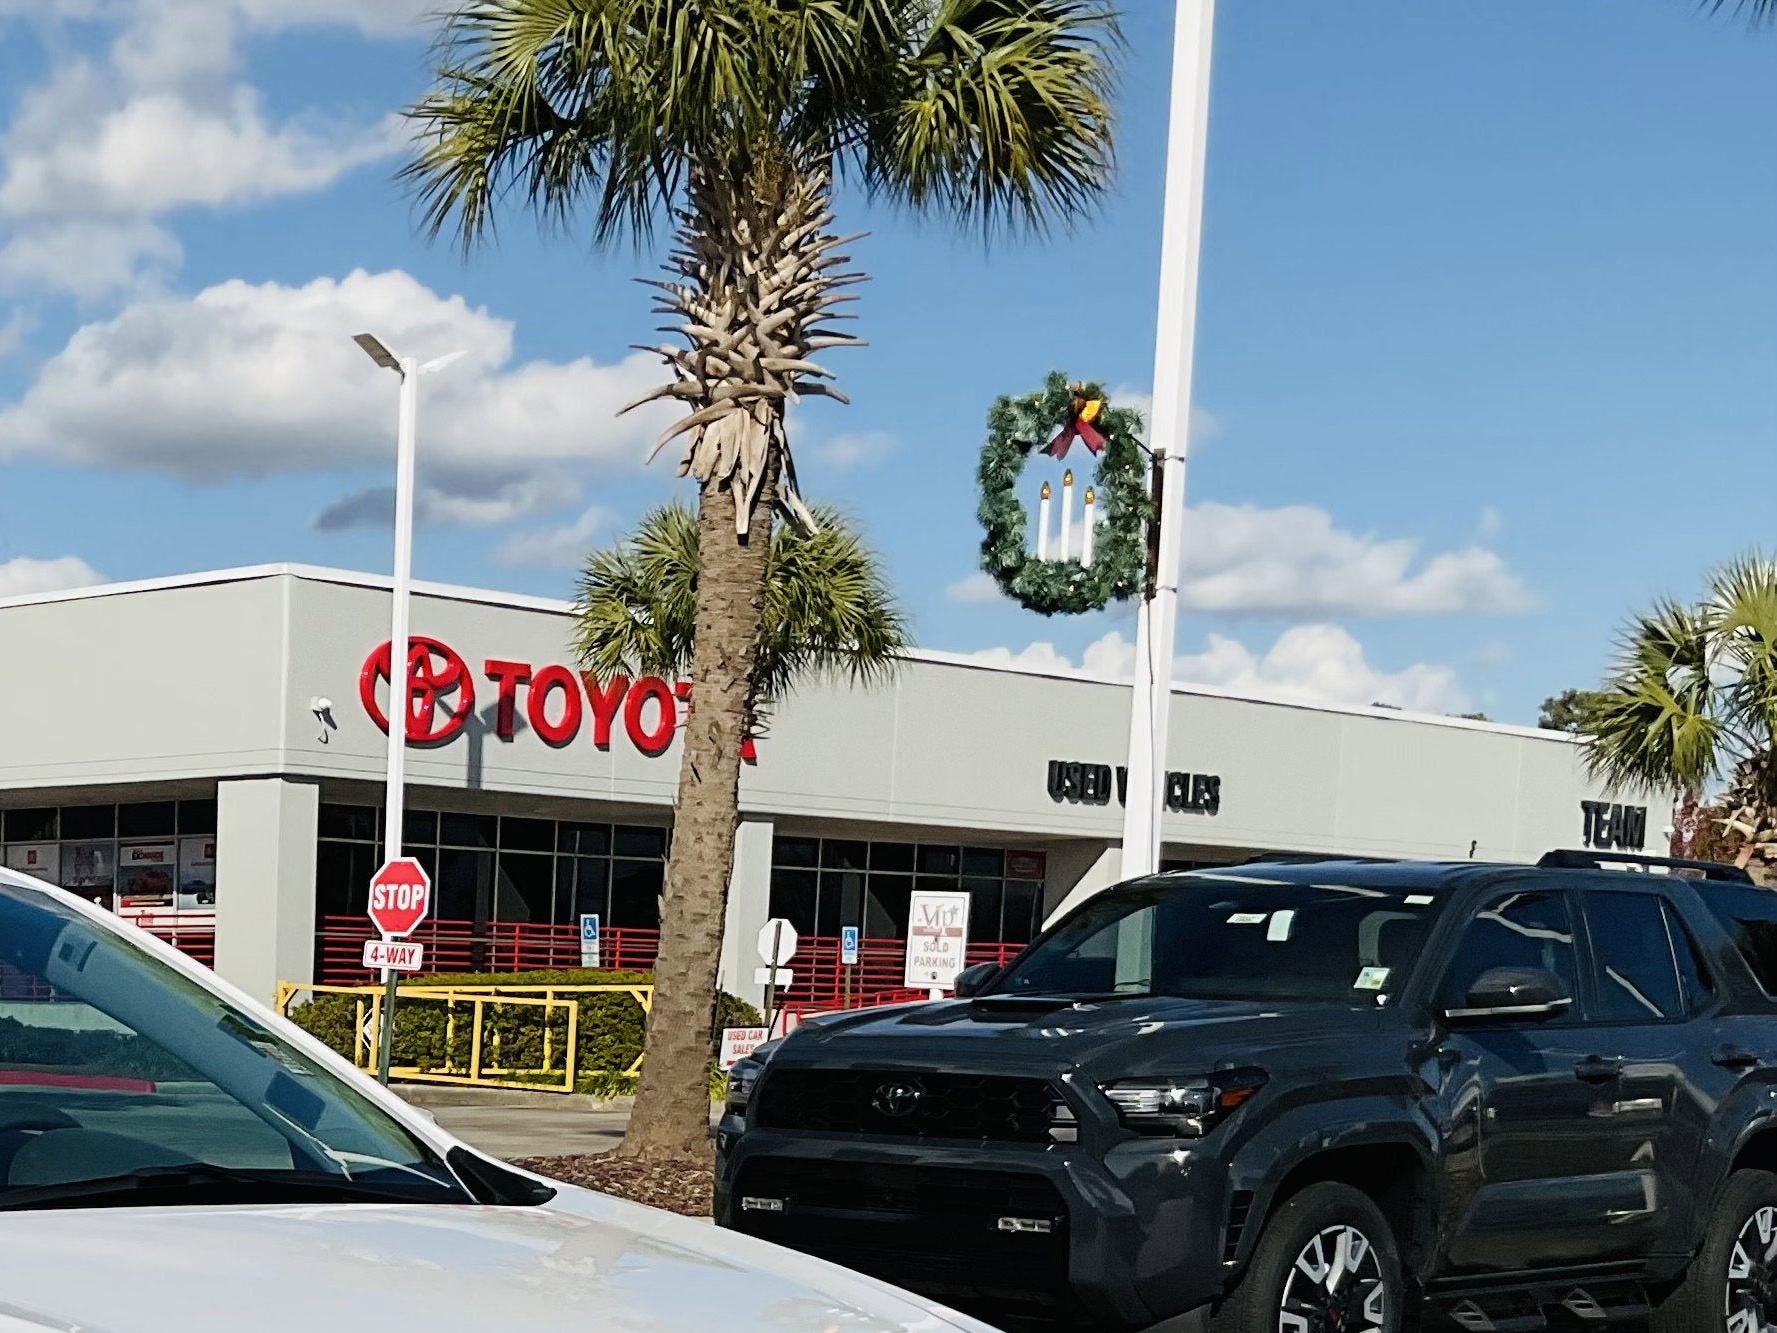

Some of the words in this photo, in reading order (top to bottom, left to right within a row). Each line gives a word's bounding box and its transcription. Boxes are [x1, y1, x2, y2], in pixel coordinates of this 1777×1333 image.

[484, 659, 757, 765] TOYO
[1048, 760, 1111, 806] USED
[1581, 801, 1647, 852] TEAM
[373, 883, 424, 911] STOP
[370, 946, 415, 965] 4-WAY
[923, 941, 949, 953] SOLD
[913, 955, 956, 969] PARKING
[727, 1030, 746, 1041] USED
[748, 1029, 764, 1041] CAR
